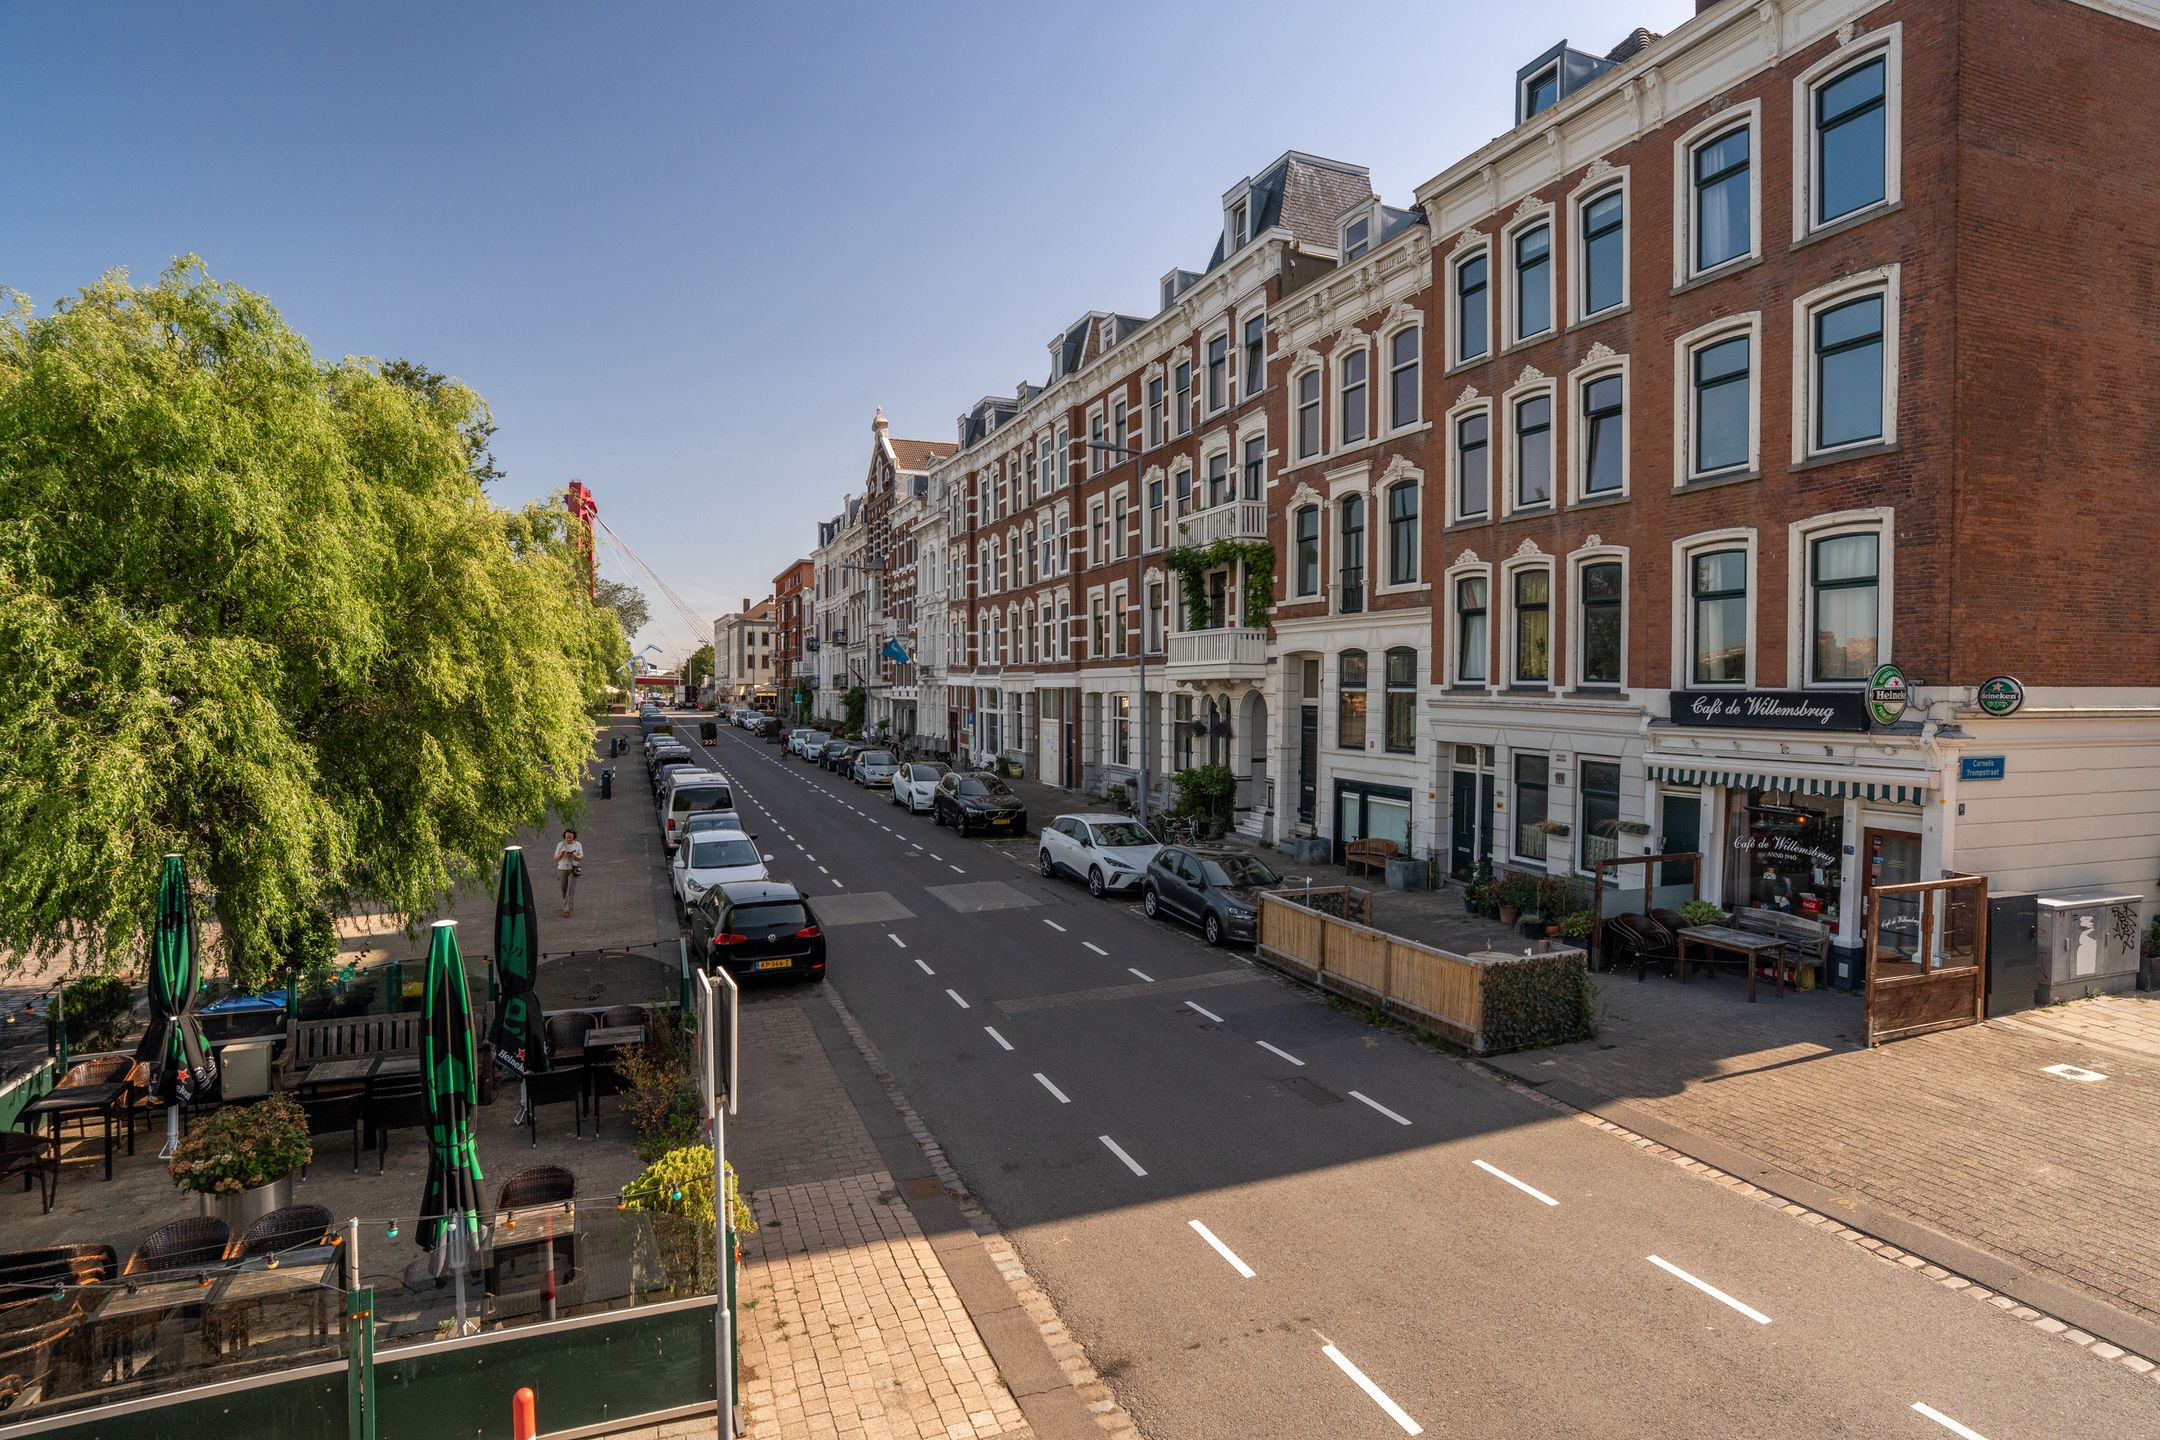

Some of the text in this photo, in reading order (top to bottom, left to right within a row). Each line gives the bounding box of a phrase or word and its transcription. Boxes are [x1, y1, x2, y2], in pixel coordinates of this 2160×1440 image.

[1691, 696, 1835, 725] Café de Willemsbrug
[1733, 835, 1836, 866] Café de Willemsbrug
